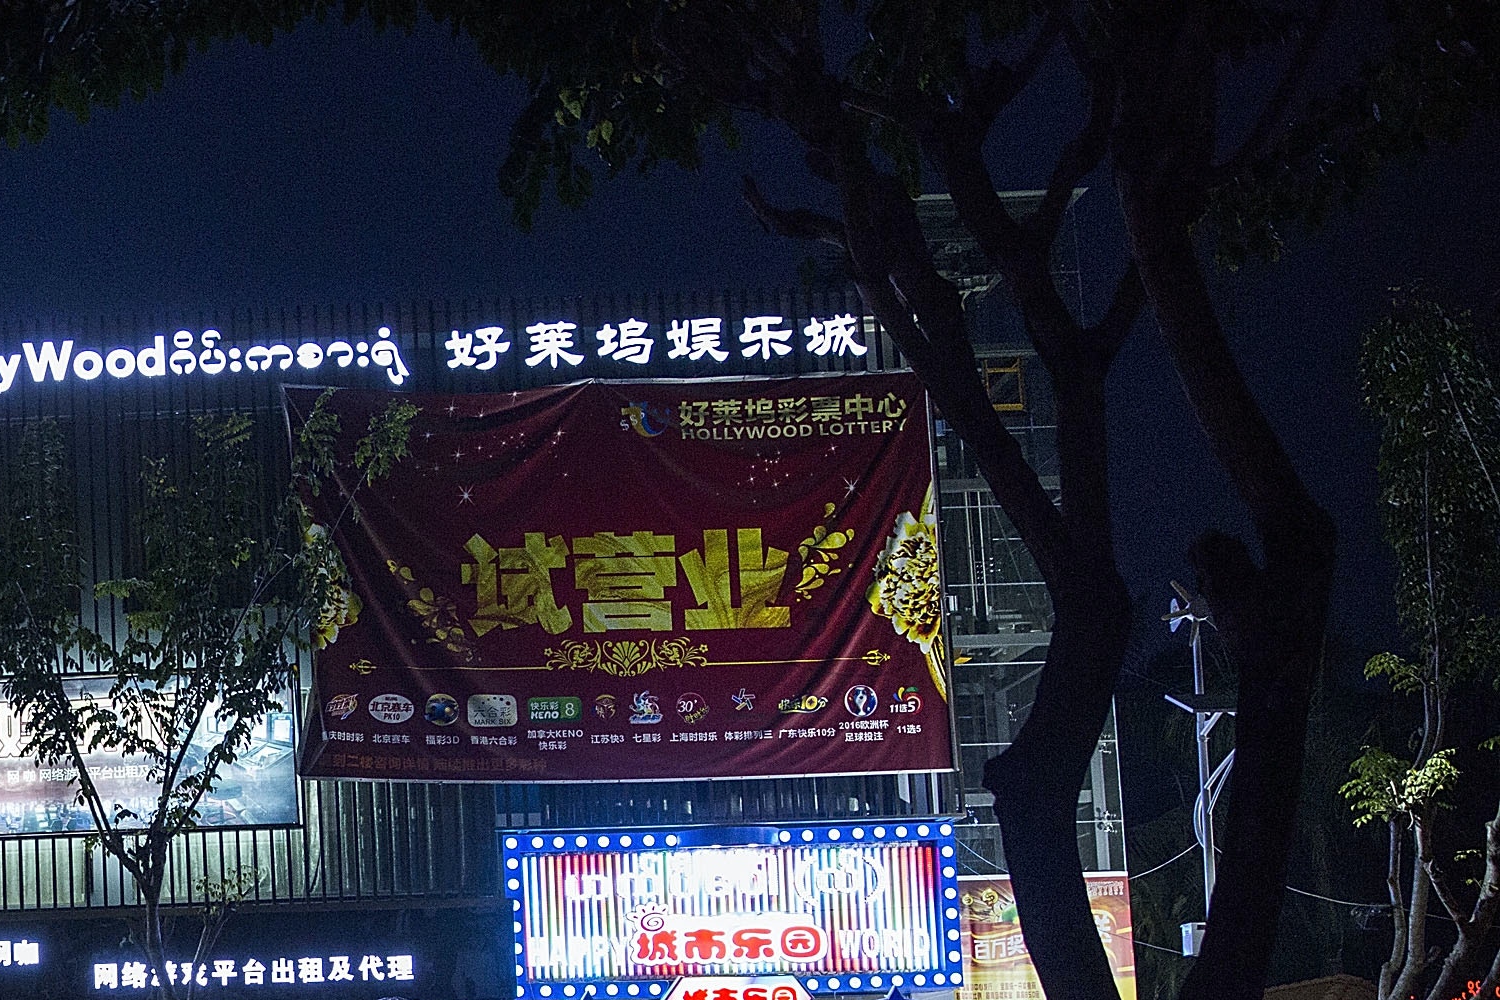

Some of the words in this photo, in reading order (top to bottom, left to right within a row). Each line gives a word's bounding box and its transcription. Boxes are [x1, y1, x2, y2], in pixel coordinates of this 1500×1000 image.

[445, 313, 869, 370] 好莱坞娱乐城
[678, 392, 907, 427] 好莱坞彩票中心
[682, 424, 813, 440] HOLLYWOOD
[819, 418, 908, 436] LOTTERY
[461, 528, 791, 637] 试营业
[474, 708, 511, 718] 六合彩
[530, 701, 558, 711] 快乐彩
[565, 703, 575, 717] 8
[530, 711, 560, 719] KENO
[474, 718, 495, 726] MARK
[499, 718, 511, 726] SIX
[839, 720, 889, 730] 2016欧洲杯
[527, 729, 584, 739] 加拿大KENO
[778, 728, 836, 738] 广东快乐10分
[897, 725, 922, 734] 11选5
[372, 734, 411, 744] 北京赛车
[425, 734, 460, 745] 福彩3D
[470, 735, 518, 746] 香港六合彩
[591, 734, 625, 744] 江苏快3
[633, 733, 661, 743] 七星彩
[670, 732, 718, 742] 上海时时乐
[724, 730, 774, 741] 体彩排列三
[844, 731, 884, 742] 足球投注
[538, 741, 567, 750] 快乐彩
[637, 925, 821, 961] 城市乐园
